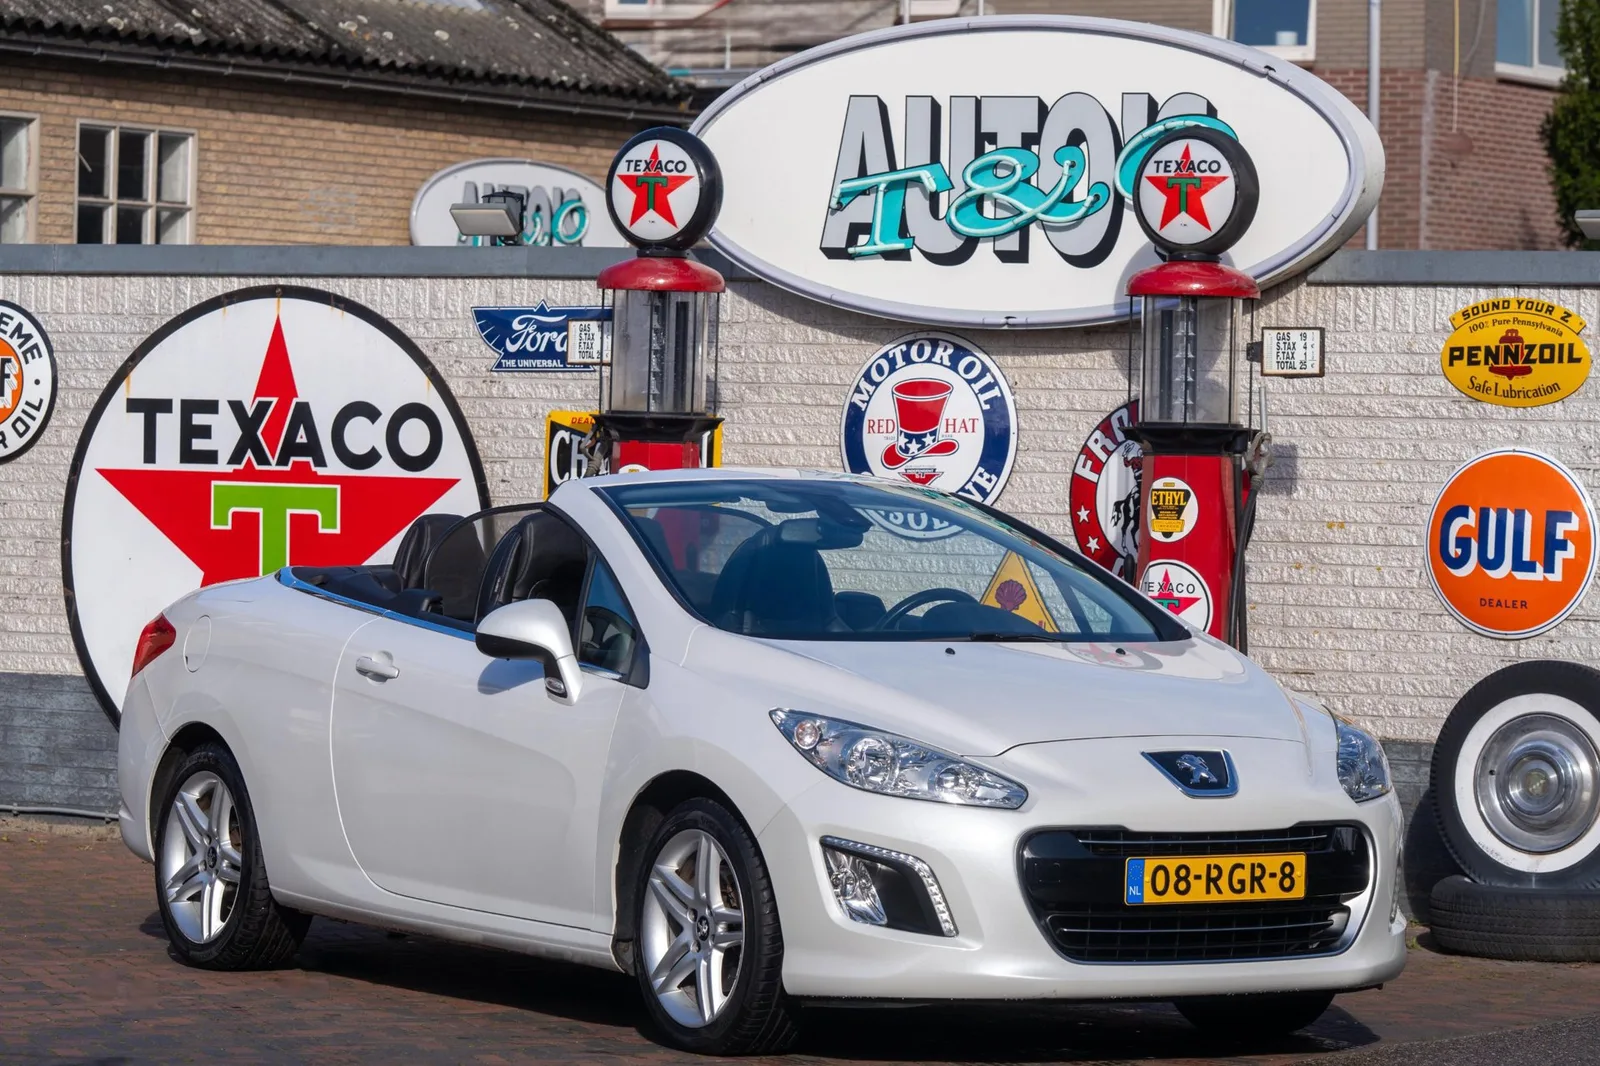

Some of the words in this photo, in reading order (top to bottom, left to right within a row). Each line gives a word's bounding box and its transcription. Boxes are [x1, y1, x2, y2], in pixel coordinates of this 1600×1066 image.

[625, 160, 687, 173] TEXACO
[1154, 160, 1221, 174] TEXACO
[636, 175, 668, 211] T
[1167, 177, 1202, 214] T
[1461, 299, 1511, 321] SOUND
[1516, 299, 1555, 315] YOUR
[1560, 311, 1573, 324] Z
[579, 323, 591, 333] GAS
[1492, 319, 1512, 327] Pure
[1512, 317, 1563, 337] Pennsylvania
[578, 333, 595, 341] S.TAX
[1276, 332, 1291, 341] GAS
[1299, 332, 1307, 341] 19
[578, 342, 594, 350] F.TAX
[1276, 342, 1296, 351] S.TAX
[578, 351, 595, 360] TOTAL
[1276, 351, 1295, 360] F.TAX
[1448, 342, 1583, 367] PENNZOIL
[501, 359, 517, 367] THE
[517, 359, 564, 368] UNIVERSAL
[1276, 361, 1297, 370] TOTAL
[1299, 361, 1307, 370] 25
[850, 339, 955, 412] MOTOR
[957, 355, 1002, 411] OIL
[1467, 375, 1492, 395] Safe
[1494, 382, 1561, 399] Lubrication
[11, 398, 44, 438] OIL
[867, 418, 896, 434] RED
[945, 417, 979, 434] HAT
[126, 397, 443, 472] TEXACO
[1151, 490, 1187, 506] ETHYL
[211, 481, 341, 577] T
[1440, 505, 1580, 582] GULF
[1479, 598, 1528, 609] DEALER
[1129, 885, 1142, 896] NL
[1150, 861, 1296, 897] 08-RGR-8
